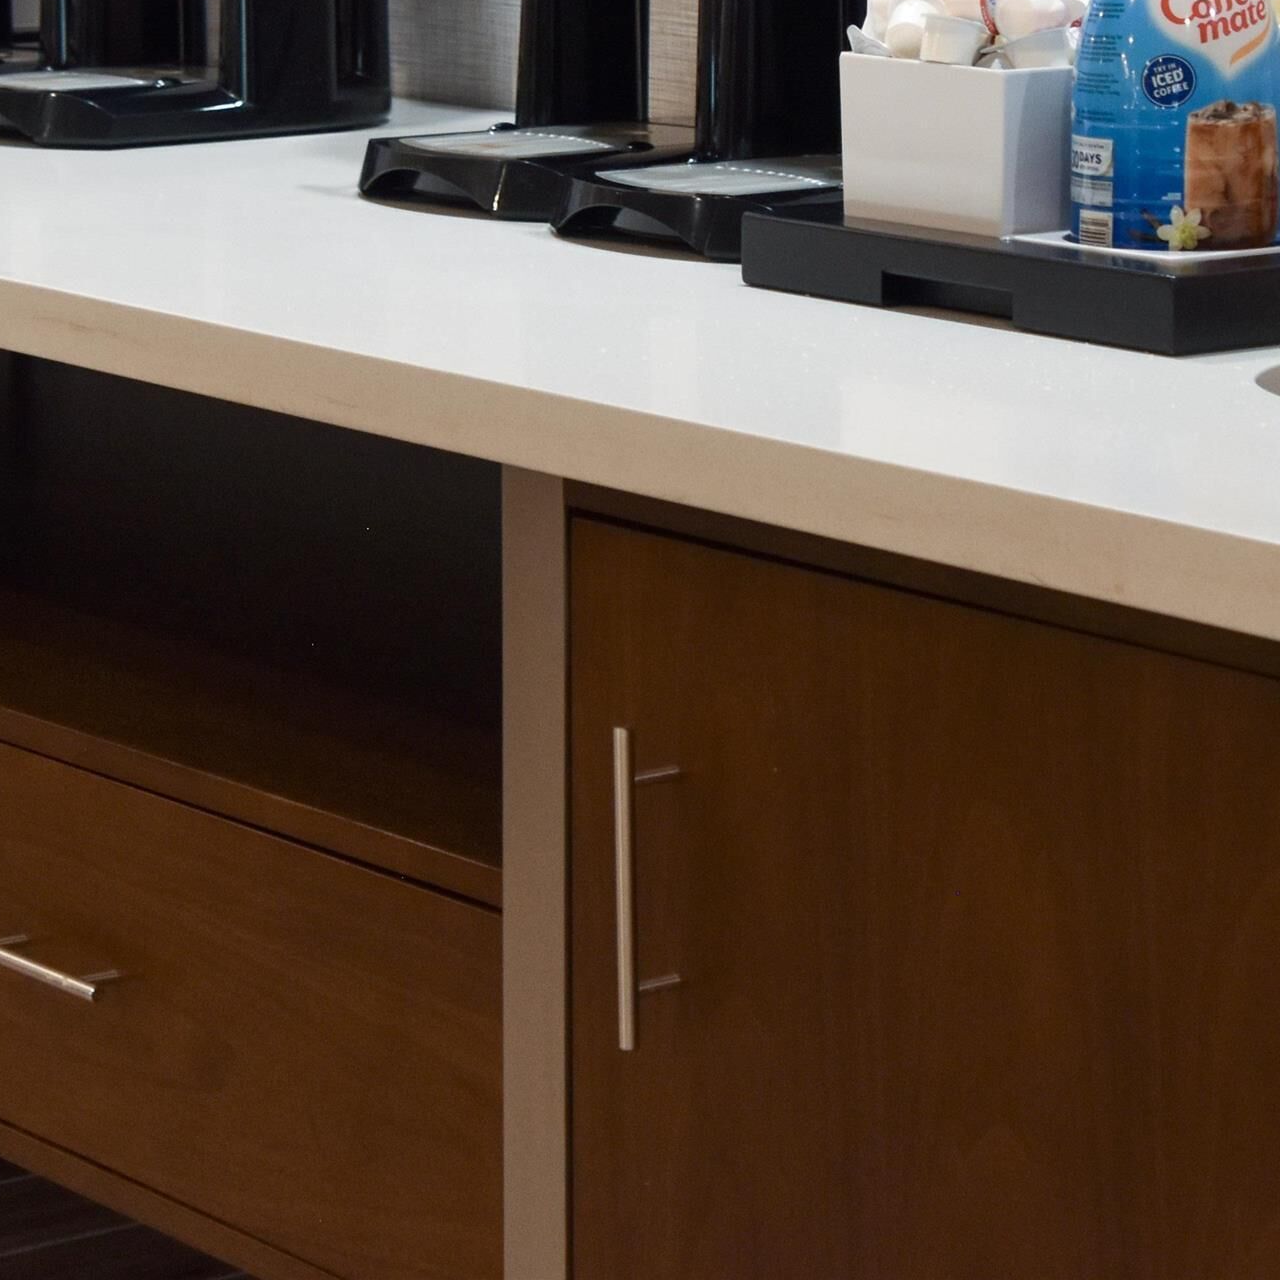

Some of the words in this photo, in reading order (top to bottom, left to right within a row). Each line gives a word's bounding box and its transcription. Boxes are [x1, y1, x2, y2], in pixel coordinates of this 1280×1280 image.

[1197, 0, 1266, 44] mate
[1153, 65, 1166, 74] TRY
[1151, 69, 1184, 88] ICED
[1153, 81, 1189, 98] COFFEE
[1079, 151, 1102, 165] DAYS
